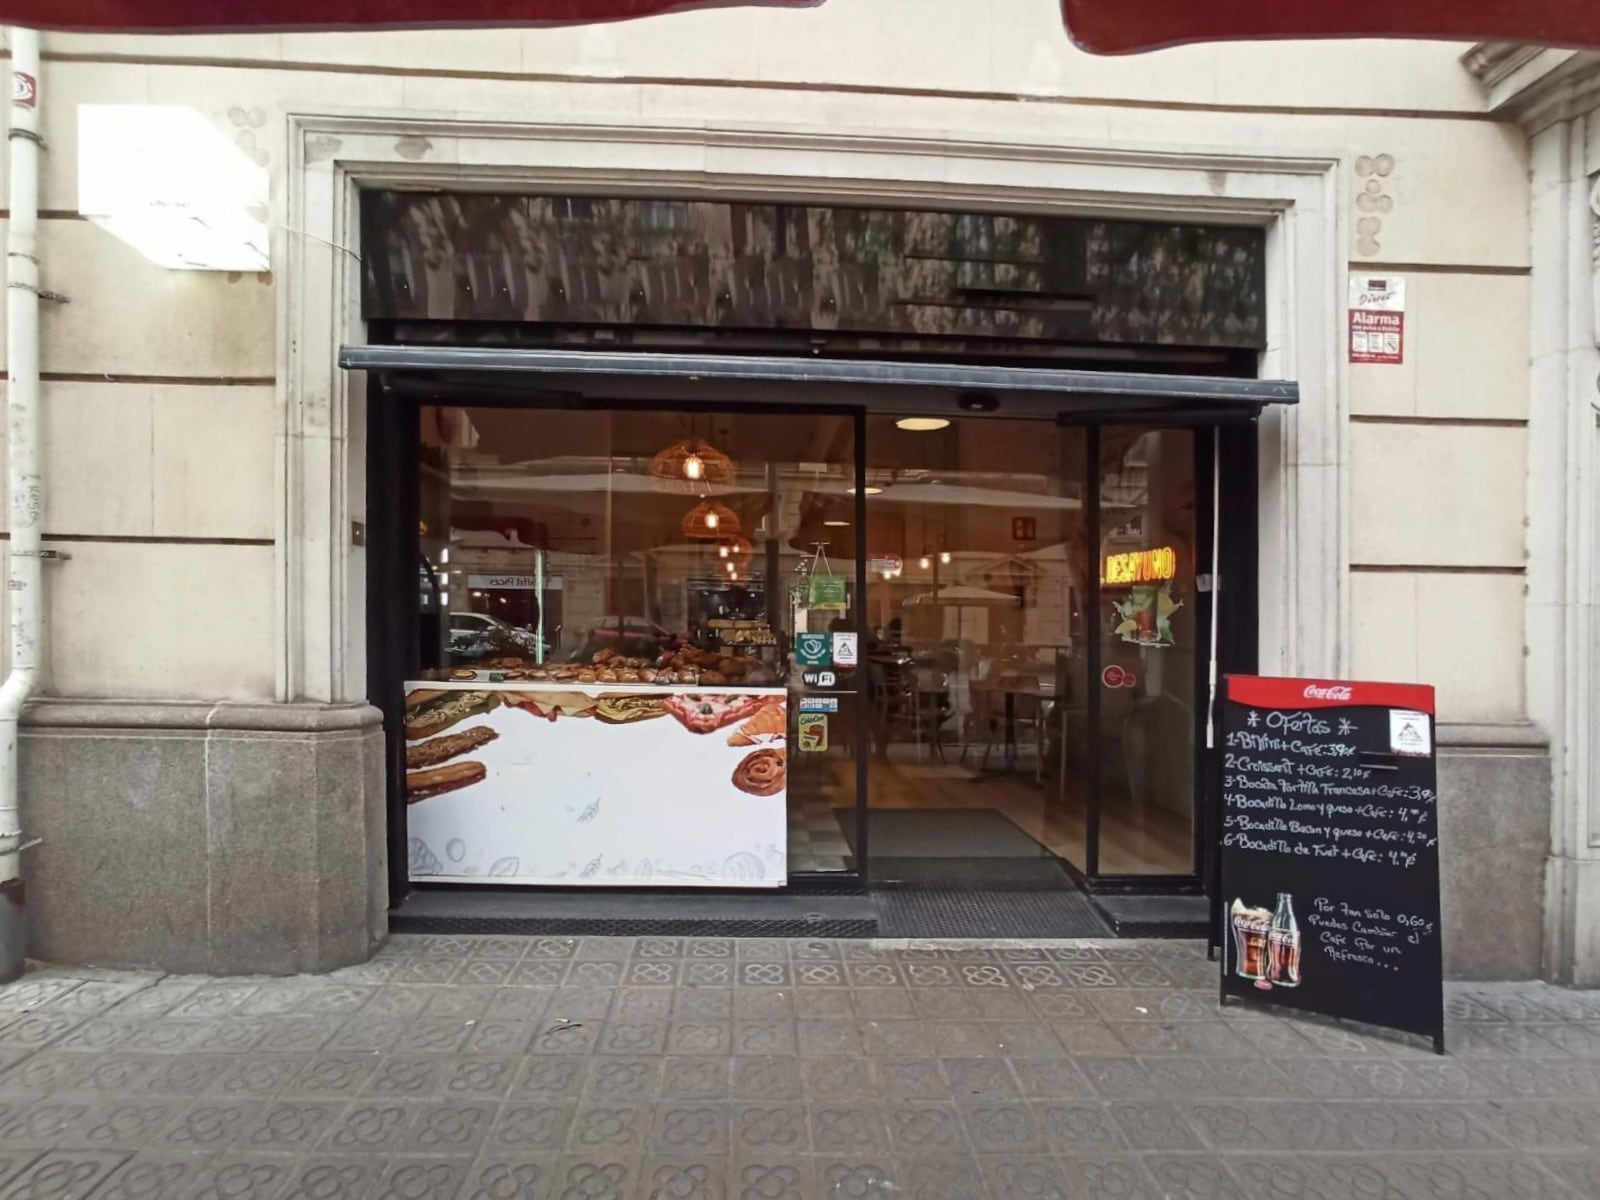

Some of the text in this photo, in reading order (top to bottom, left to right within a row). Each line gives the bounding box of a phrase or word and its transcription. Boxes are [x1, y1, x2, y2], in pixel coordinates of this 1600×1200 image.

[1352, 311, 1400, 325] Alarma
[1106, 546, 1174, 583] DESAYUNO
[1266, 711, 1331, 735] Ofertas
[1289, 821, 1322, 834] Bacon
[1294, 842, 1310, 855] de
[1314, 897, 1336, 912] Por
[1308, 914, 1348, 930] Puedes
